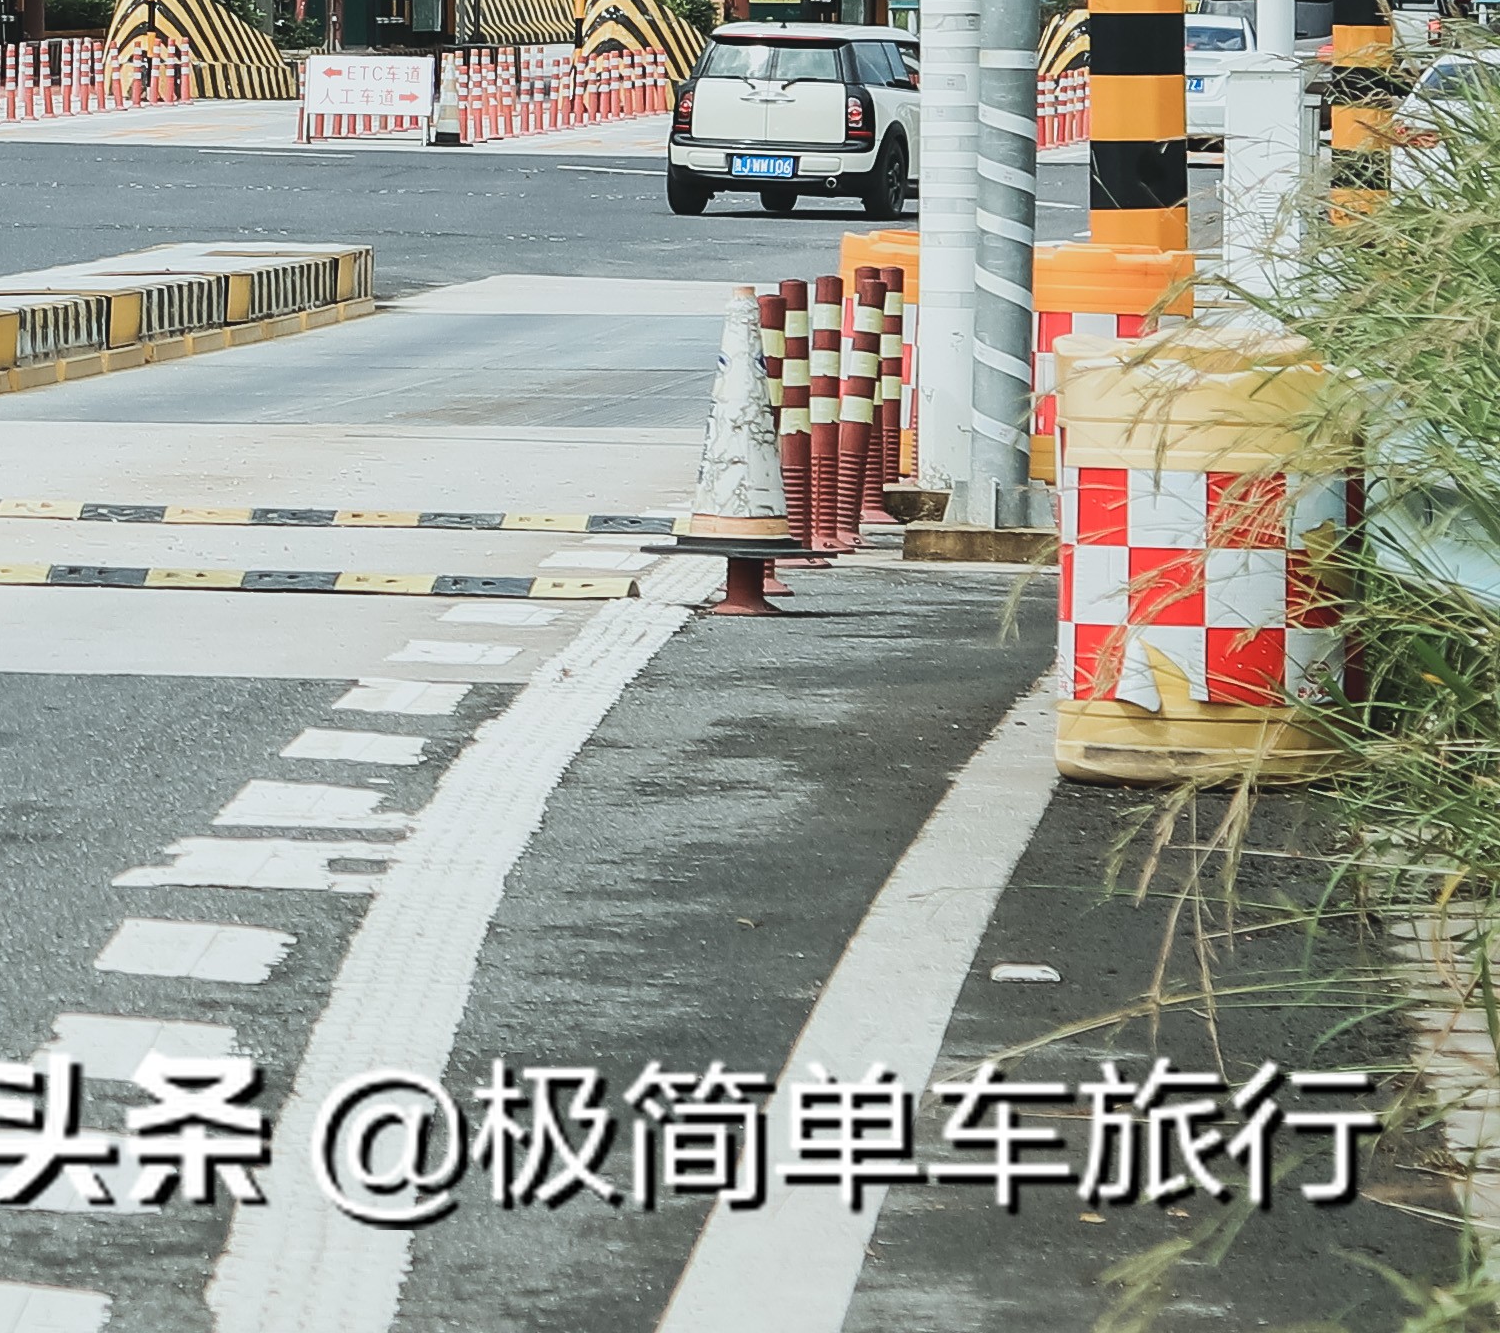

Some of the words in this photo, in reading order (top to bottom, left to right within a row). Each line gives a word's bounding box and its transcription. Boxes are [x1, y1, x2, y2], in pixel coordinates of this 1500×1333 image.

[347, 65, 421, 83] ETC车道
[319, 87, 394, 106] 人工车道
